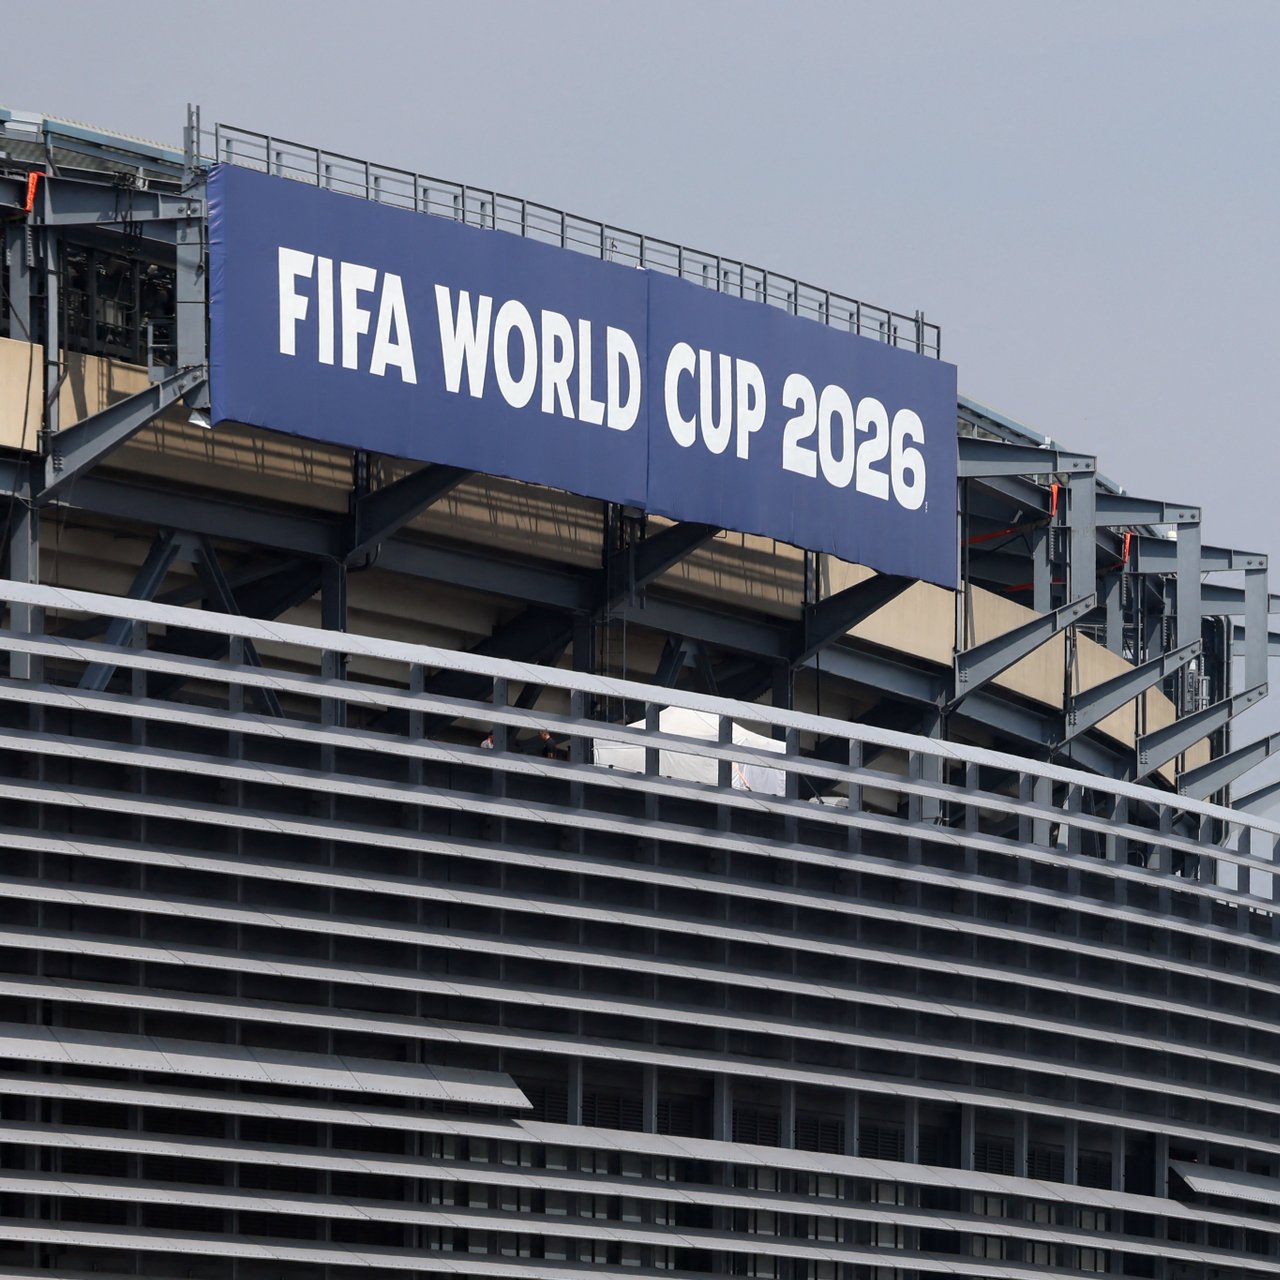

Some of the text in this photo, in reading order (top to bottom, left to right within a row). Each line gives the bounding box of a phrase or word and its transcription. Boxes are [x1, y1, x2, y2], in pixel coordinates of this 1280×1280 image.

[278, 246, 928, 511] FIFA WORLD CUP 2026
